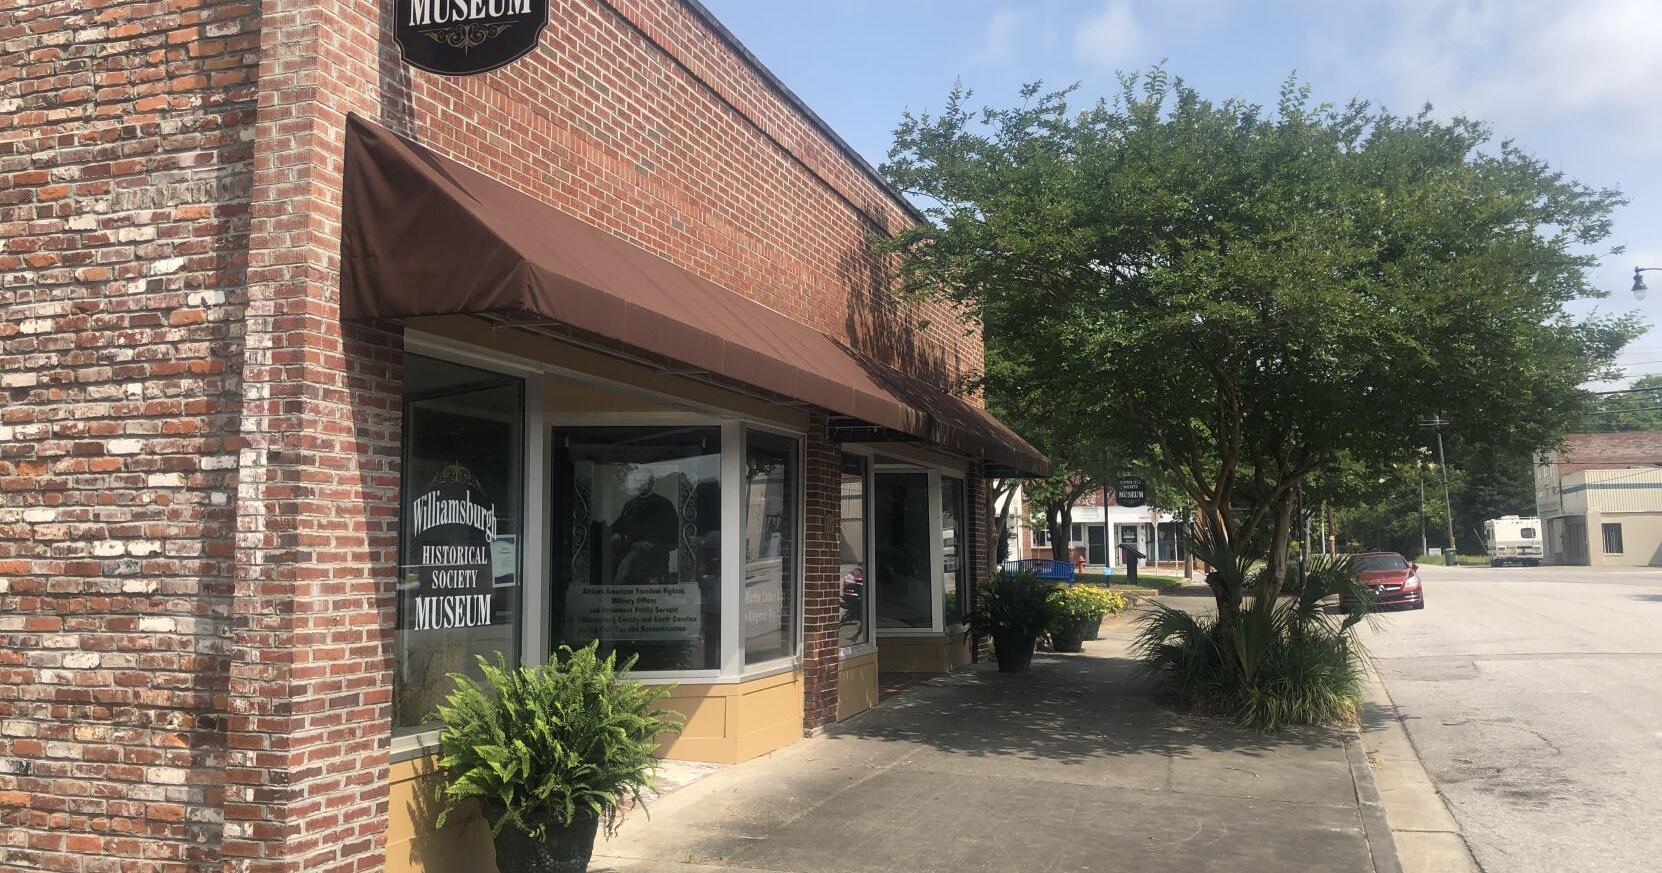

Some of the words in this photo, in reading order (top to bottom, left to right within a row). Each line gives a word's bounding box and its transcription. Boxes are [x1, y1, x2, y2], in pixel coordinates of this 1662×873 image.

[408, 0, 532, 27] MUSEUM
[1118, 491, 1144, 499] MUSEUM
[413, 490, 497, 542] Williamsburgh
[422, 545, 488, 565] HISTORICAL
[431, 569, 478, 589] SOCIETY
[606, 587, 634, 595] American
[635, 587, 662, 595] Freedom
[414, 594, 492, 631] MUSEUM
[655, 606, 679, 614] Servant
